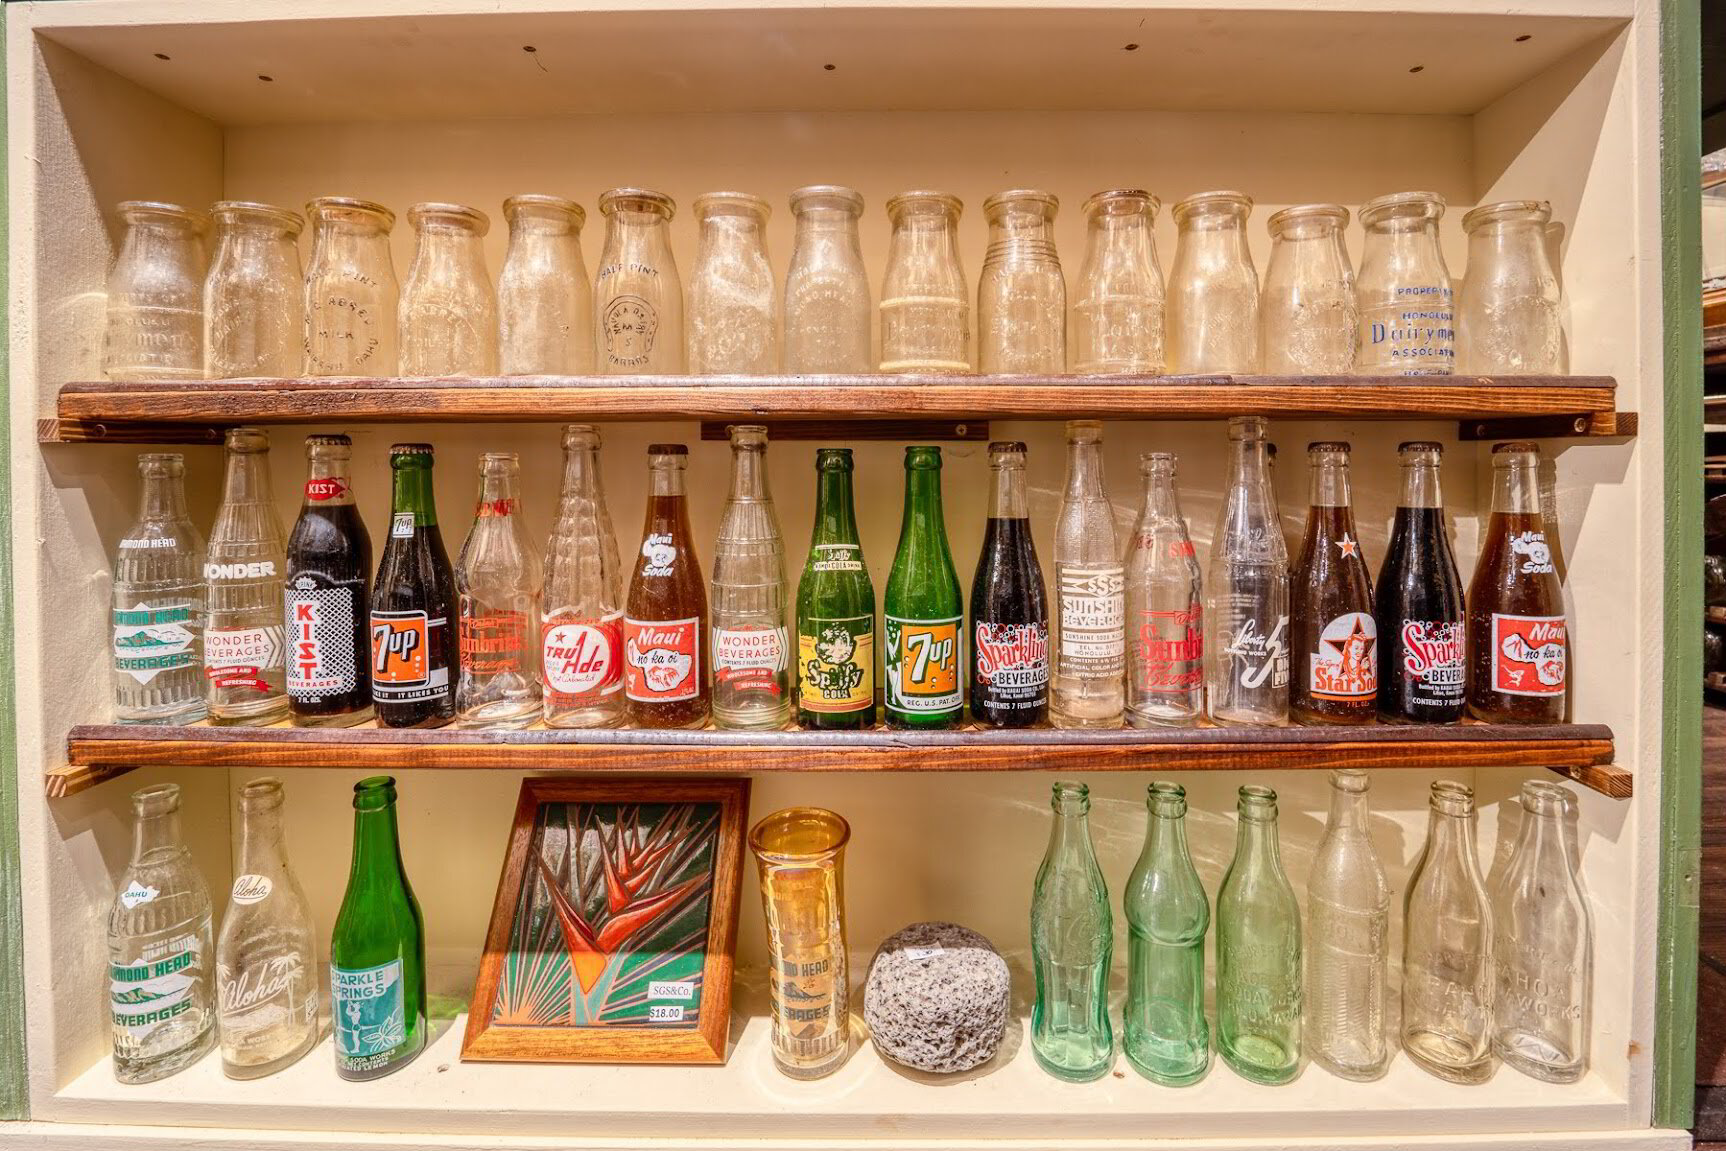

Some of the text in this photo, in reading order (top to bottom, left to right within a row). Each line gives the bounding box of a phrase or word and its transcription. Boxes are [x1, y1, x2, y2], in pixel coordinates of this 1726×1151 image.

[602, 264, 659, 279] HALF PINT
[308, 483, 336, 495] KIST
[151, 537, 176, 548] HEAD
[649, 533, 673, 546] Maui
[642, 564, 675, 577] Soda
[831, 561, 847, 570] COLA
[1520, 562, 1553, 574] Soda
[638, 627, 685, 646] Maui
[1528, 622, 1565, 641] Mau
[297, 604, 318, 680] KIST
[722, 634, 776, 647] WONDER
[373, 623, 419, 674] 7up
[547, 645, 577, 660] TRU
[719, 645, 781, 659] BEVERAGES
[637, 653, 648, 665] no
[651, 651, 665, 664] ka
[907, 632, 953, 685] 7up
[1060, 661, 1089, 671] ARTIFICIAL
[1315, 667, 1352, 693] Star
[1432, 669, 1465, 683] BEVERA
[288, 679, 339, 688] BEVERAGES
[408, 689, 432, 699] LIKES
[434, 684, 449, 695] YOU
[823, 689, 851, 699] COLA
[906, 699, 923, 707] REG.
[983, 699, 1010, 710] CONTENTS
[1412, 697, 1443, 706] CONTENTS
[233, 876, 268, 898] Aloha
[124, 890, 148, 899] OAHU
[155, 952, 192, 978] HEAD
[801, 959, 829, 977] HEAD
[224, 963, 290, 1011] Aloha
[653, 985, 692, 997] SGS&Co.
[112, 999, 192, 1027] BEVERAGES
[649, 1008, 680, 1018] $18.00
[369, 1049, 396, 1061] WORKS
